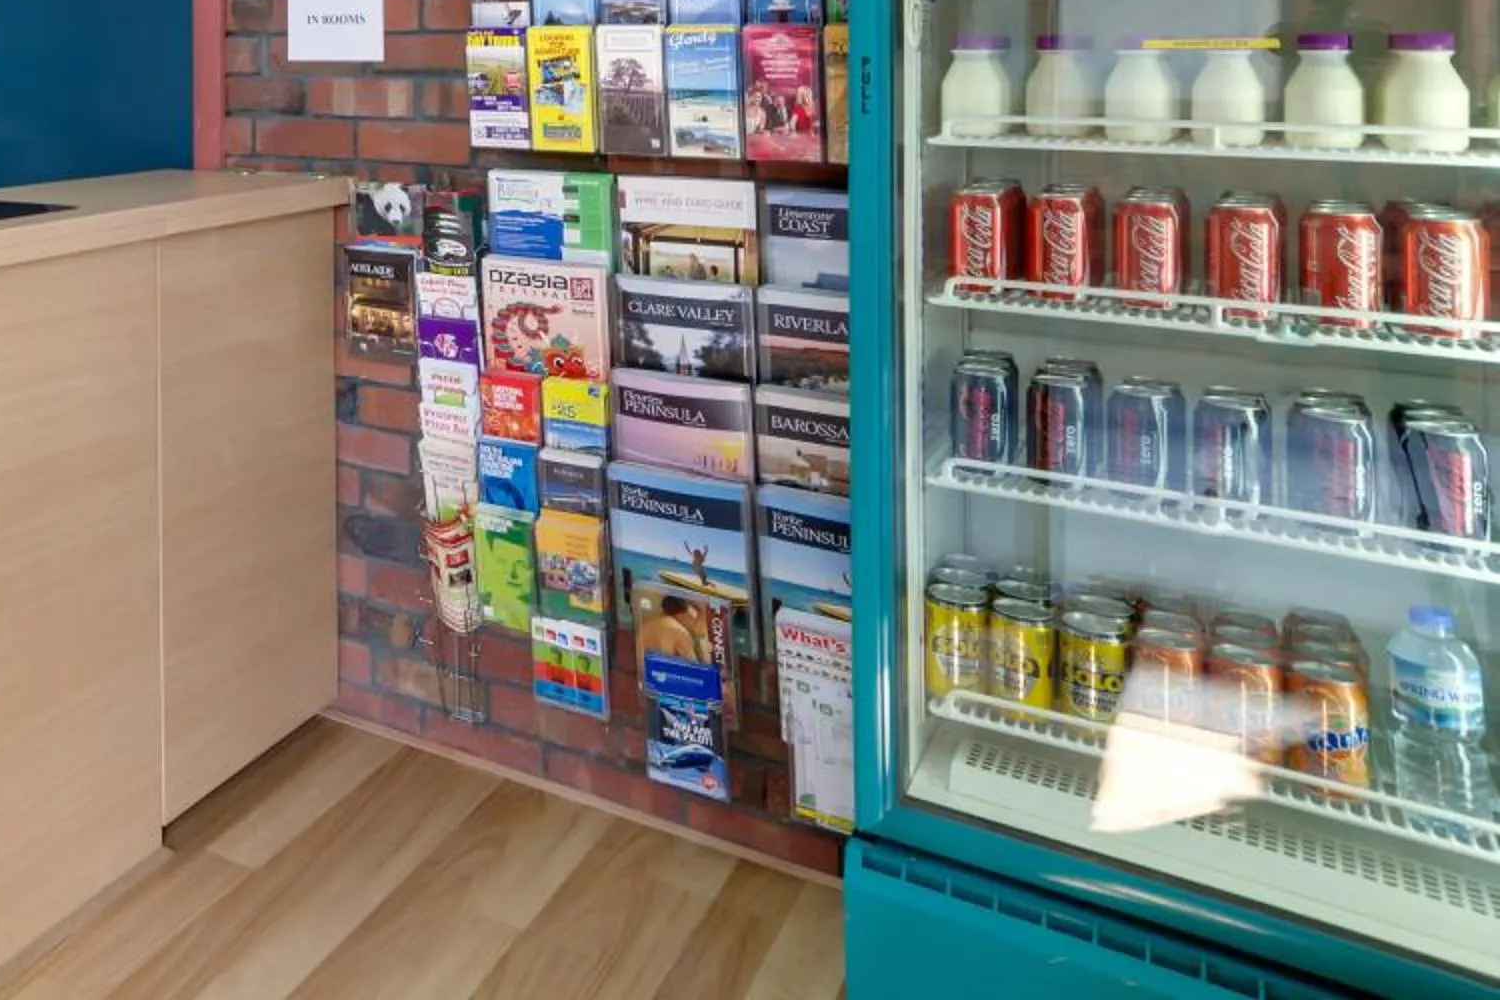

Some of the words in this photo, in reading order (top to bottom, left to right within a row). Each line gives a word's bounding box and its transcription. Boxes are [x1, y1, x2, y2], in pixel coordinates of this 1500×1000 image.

[307, 14, 319, 25] IN
[322, 13, 367, 25] ROOMS
[861, 56, 871, 115] PULL
[778, 218, 831, 234] COAST
[350, 263, 395, 279] ADELAIDE
[627, 299, 676, 318] CLARE
[678, 304, 735, 324] VALLEY
[773, 313, 849, 335] RIVERLA
[623, 398, 706, 423] PENINSULA
[771, 415, 849, 439] BAROSSA
[621, 494, 705, 522] PENINSULA
[772, 521, 849, 548] PENINSUL
[780, 627, 847, 653] What's
